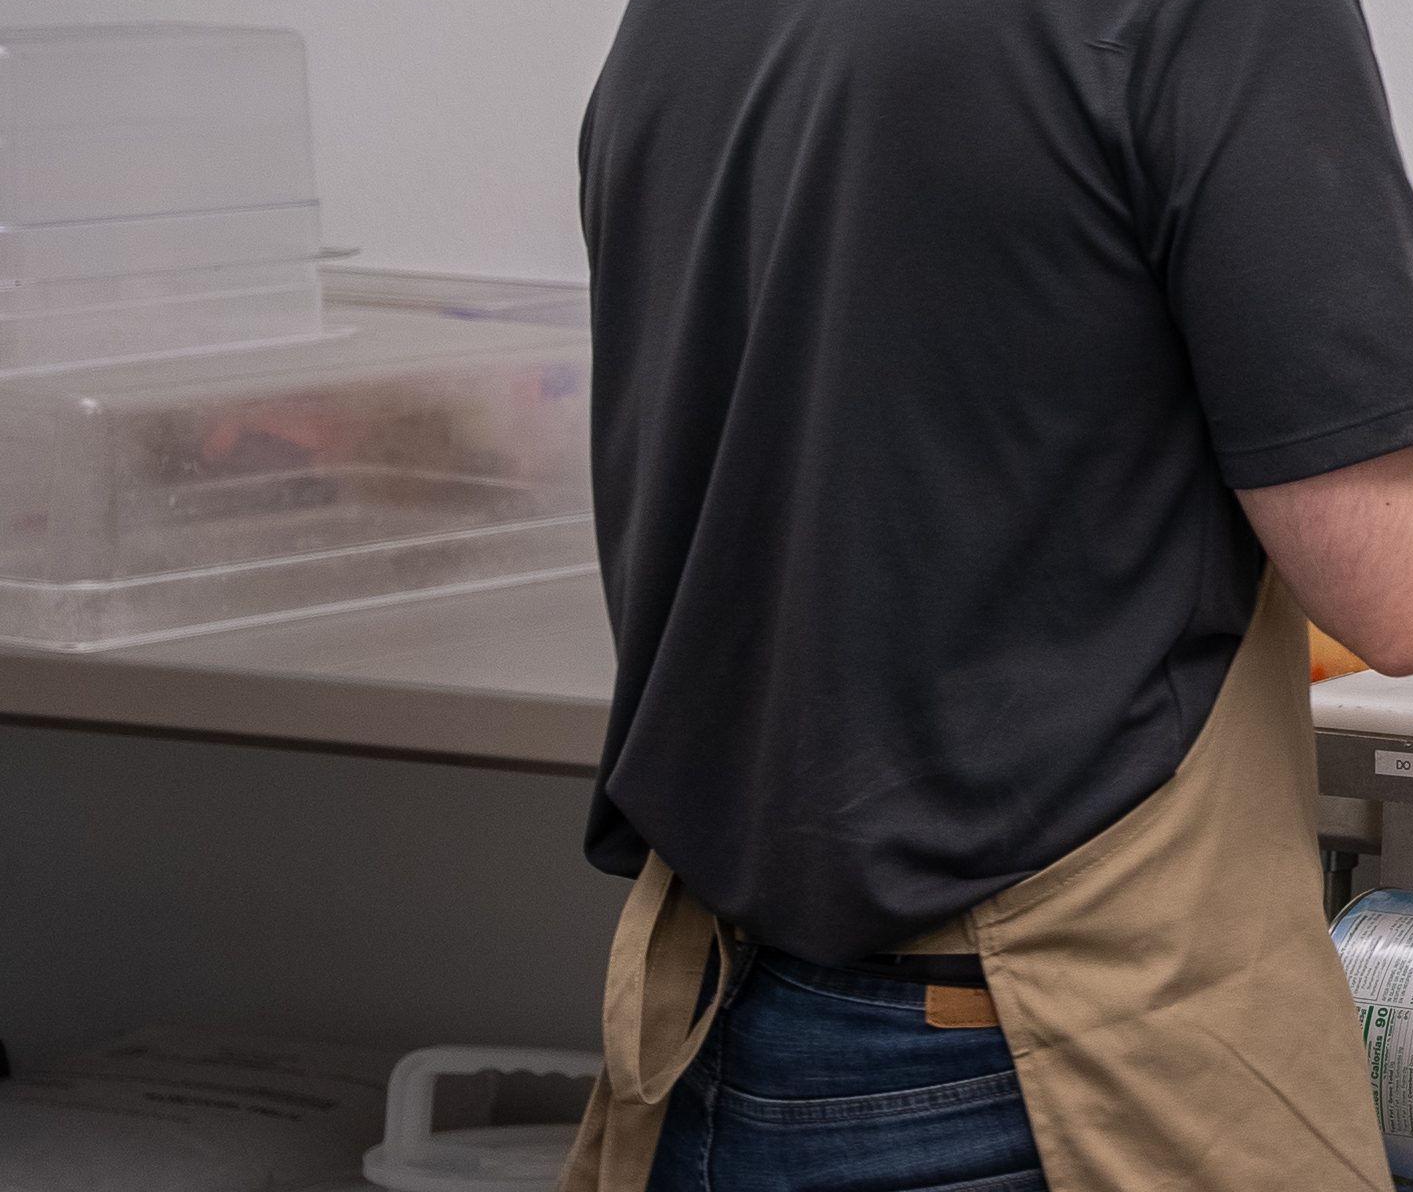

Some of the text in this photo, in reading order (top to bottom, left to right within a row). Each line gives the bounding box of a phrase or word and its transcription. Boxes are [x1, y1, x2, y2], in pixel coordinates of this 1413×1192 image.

[1396, 760, 1411, 770] DO
[1375, 1007, 1388, 1027] 90
[1370, 1035, 1383, 1078] Calorías
